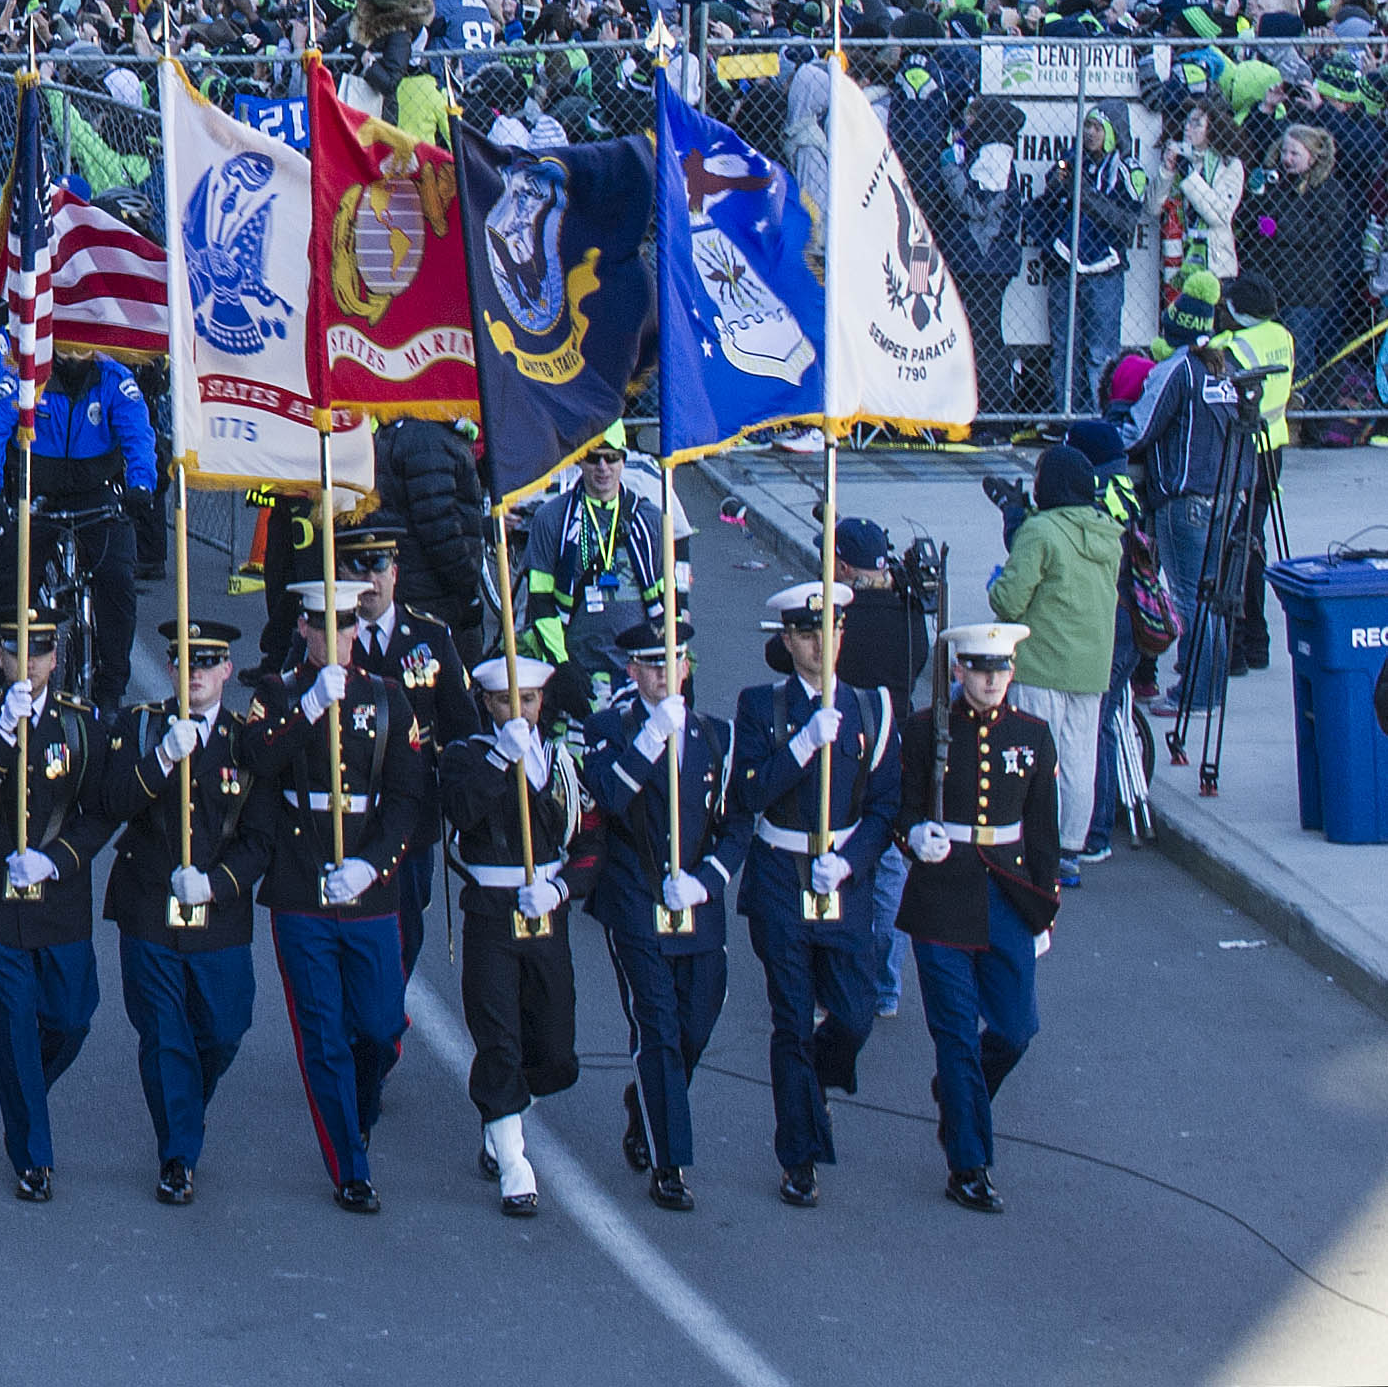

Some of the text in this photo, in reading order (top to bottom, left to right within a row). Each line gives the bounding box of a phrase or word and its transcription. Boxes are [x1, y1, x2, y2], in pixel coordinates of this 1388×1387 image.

[462, 21, 496, 50] 87
[1015, 135, 1074, 161] THAN
[860, 146, 894, 209] UNITE
[331, 331, 473, 371] STATES MARIN
[867, 321, 958, 364] SEMPER PARATUS
[523, 358, 554, 379] UNITED
[897, 366, 928, 382] 1790
[207, 377, 280, 409] STATES
[209, 416, 259, 443] 1775
